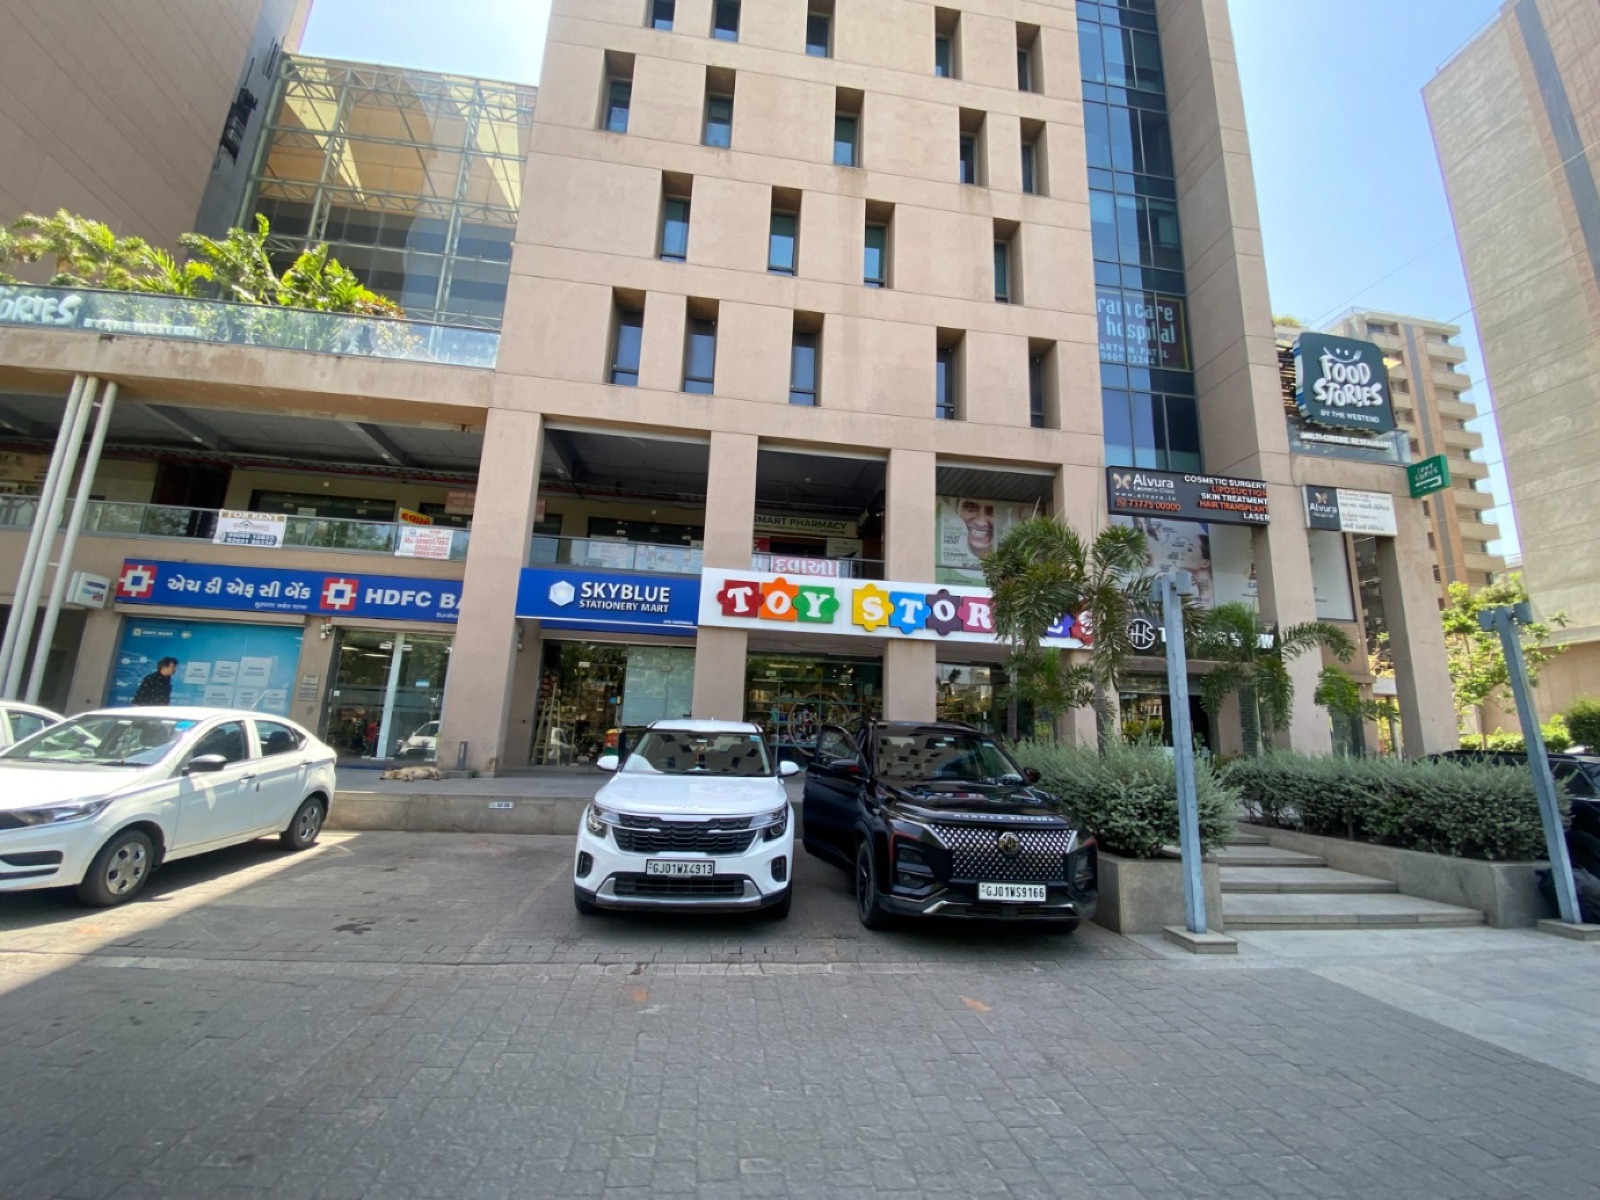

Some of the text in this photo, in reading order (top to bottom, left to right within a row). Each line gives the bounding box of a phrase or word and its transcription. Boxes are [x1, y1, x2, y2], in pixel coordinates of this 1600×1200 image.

[1134, 303, 1174, 322] care
[1319, 354, 1371, 385] FOOD
[1313, 377, 1383, 408] STORIES
[1320, 409, 1380, 423] BY THE WESTEND
[1133, 474, 1174, 488] Alvura
[1184, 475, 1267, 489] COSMETIC SURGERY
[1200, 492, 1268, 505] SKIN TREATMENT
[1211, 486, 1267, 497] LIPOSUCTION
[1199, 500, 1269, 513] HAIR TRANSPLANT
[1309, 502, 1337, 513] Alvura
[227, 511, 279, 521] FOR RENT
[754, 515, 847, 530] SMART PHARMACY
[1243, 512, 1270, 522] LASER
[167, 574, 201, 592] એચ
[204, 576, 223, 594] ડી
[226, 578, 255, 598] એફ
[259, 580, 281, 598] સી
[580, 581, 671, 603] SKYBLUE
[364, 588, 432, 608] HDFC
[727, 587, 831, 619] TOY
[579, 599, 669, 613] STATIONERY MART
[653, 863, 713, 874] GJ01WX4913
[986, 885, 1045, 898] GJ01WS9166
